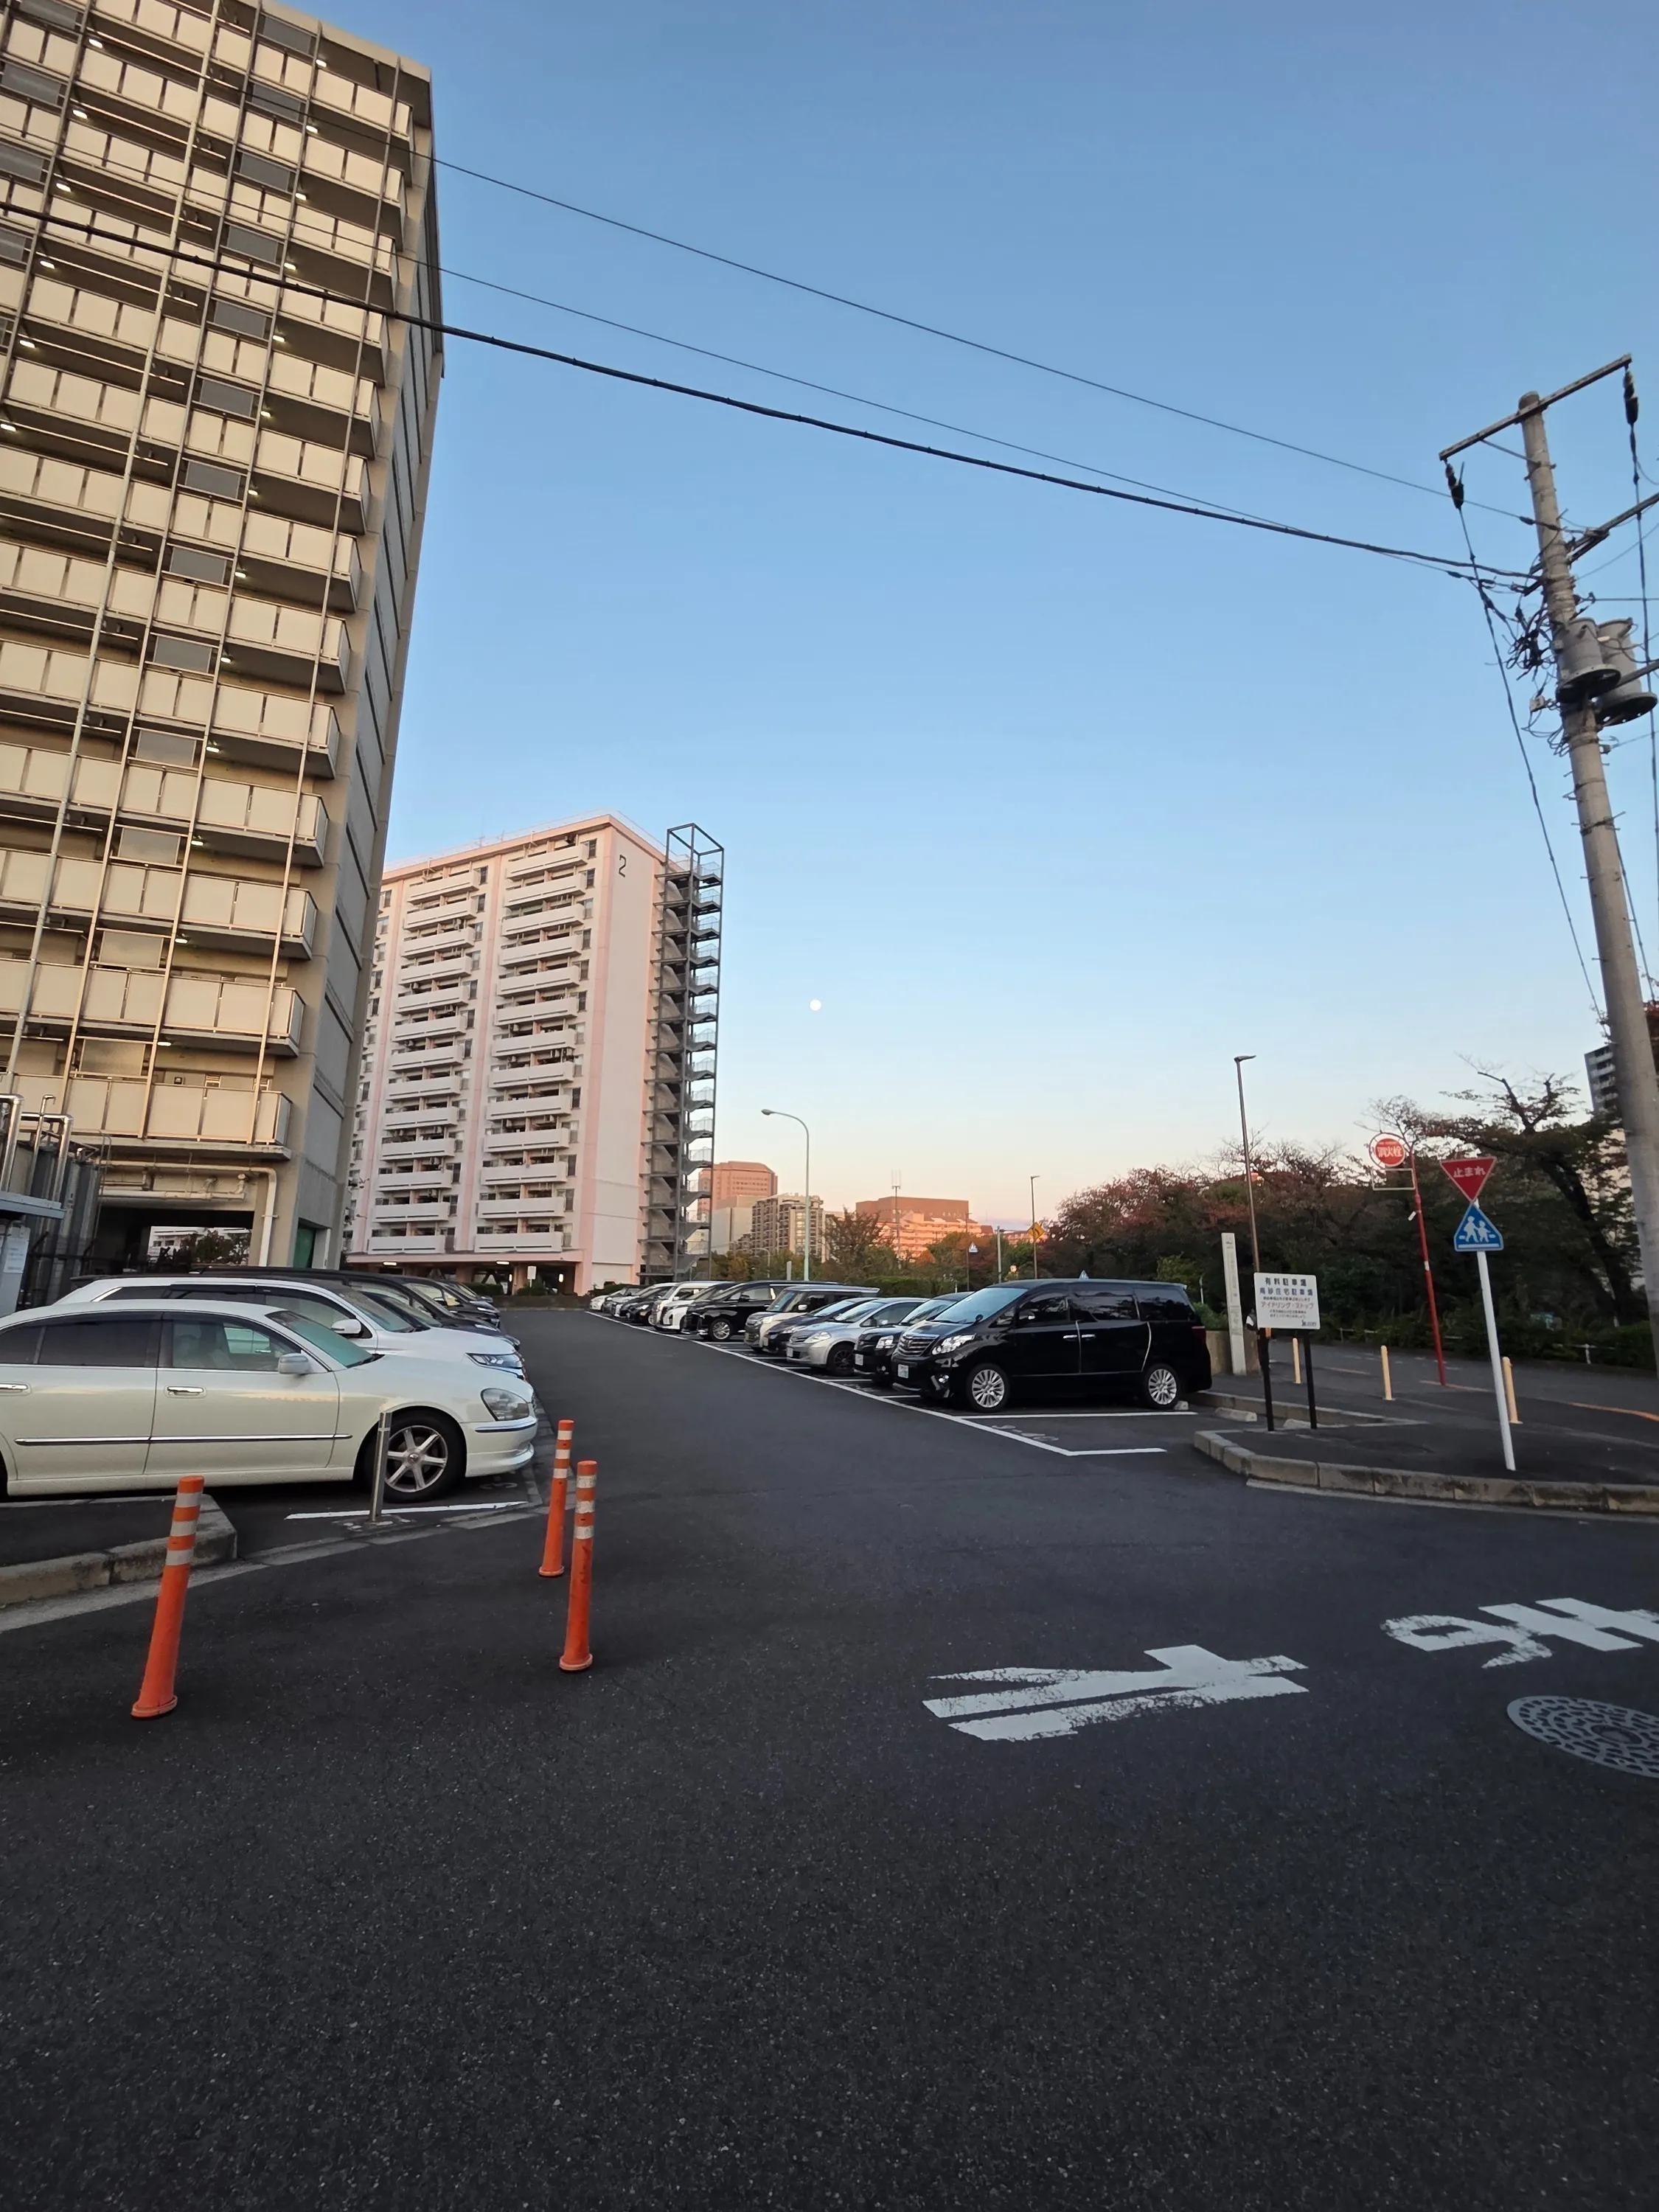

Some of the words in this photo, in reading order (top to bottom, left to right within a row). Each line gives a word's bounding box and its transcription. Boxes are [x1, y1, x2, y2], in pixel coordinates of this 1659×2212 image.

[619, 855, 627, 878] 2
[1377, 1145, 1402, 1158] 消火栓
[1453, 1166, 1486, 1178] 止まれ
